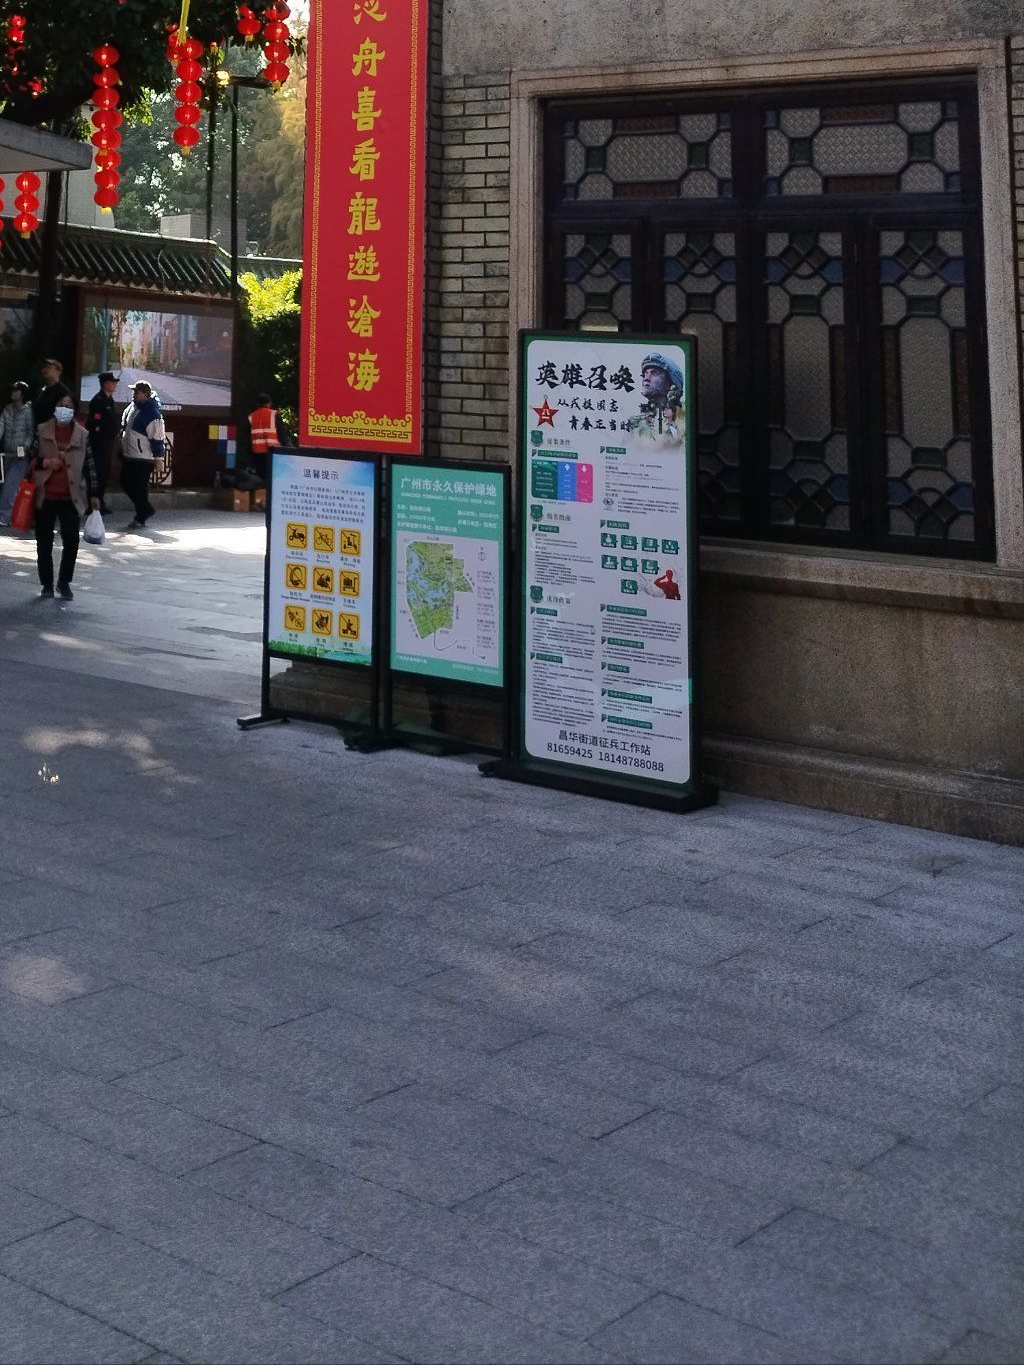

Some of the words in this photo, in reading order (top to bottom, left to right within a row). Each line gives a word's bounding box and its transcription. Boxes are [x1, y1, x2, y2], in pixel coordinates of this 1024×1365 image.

[535, 360, 636, 393] 英雄召唤
[303, 468, 339, 481] 温馨提示
[400, 476, 497, 497] 广州市永久保护绿地
[558, 729, 651, 756] 昌华街道征兵工作站
[546, 741, 593, 759] 81659425
[598, 751, 664, 772] 18148788088
